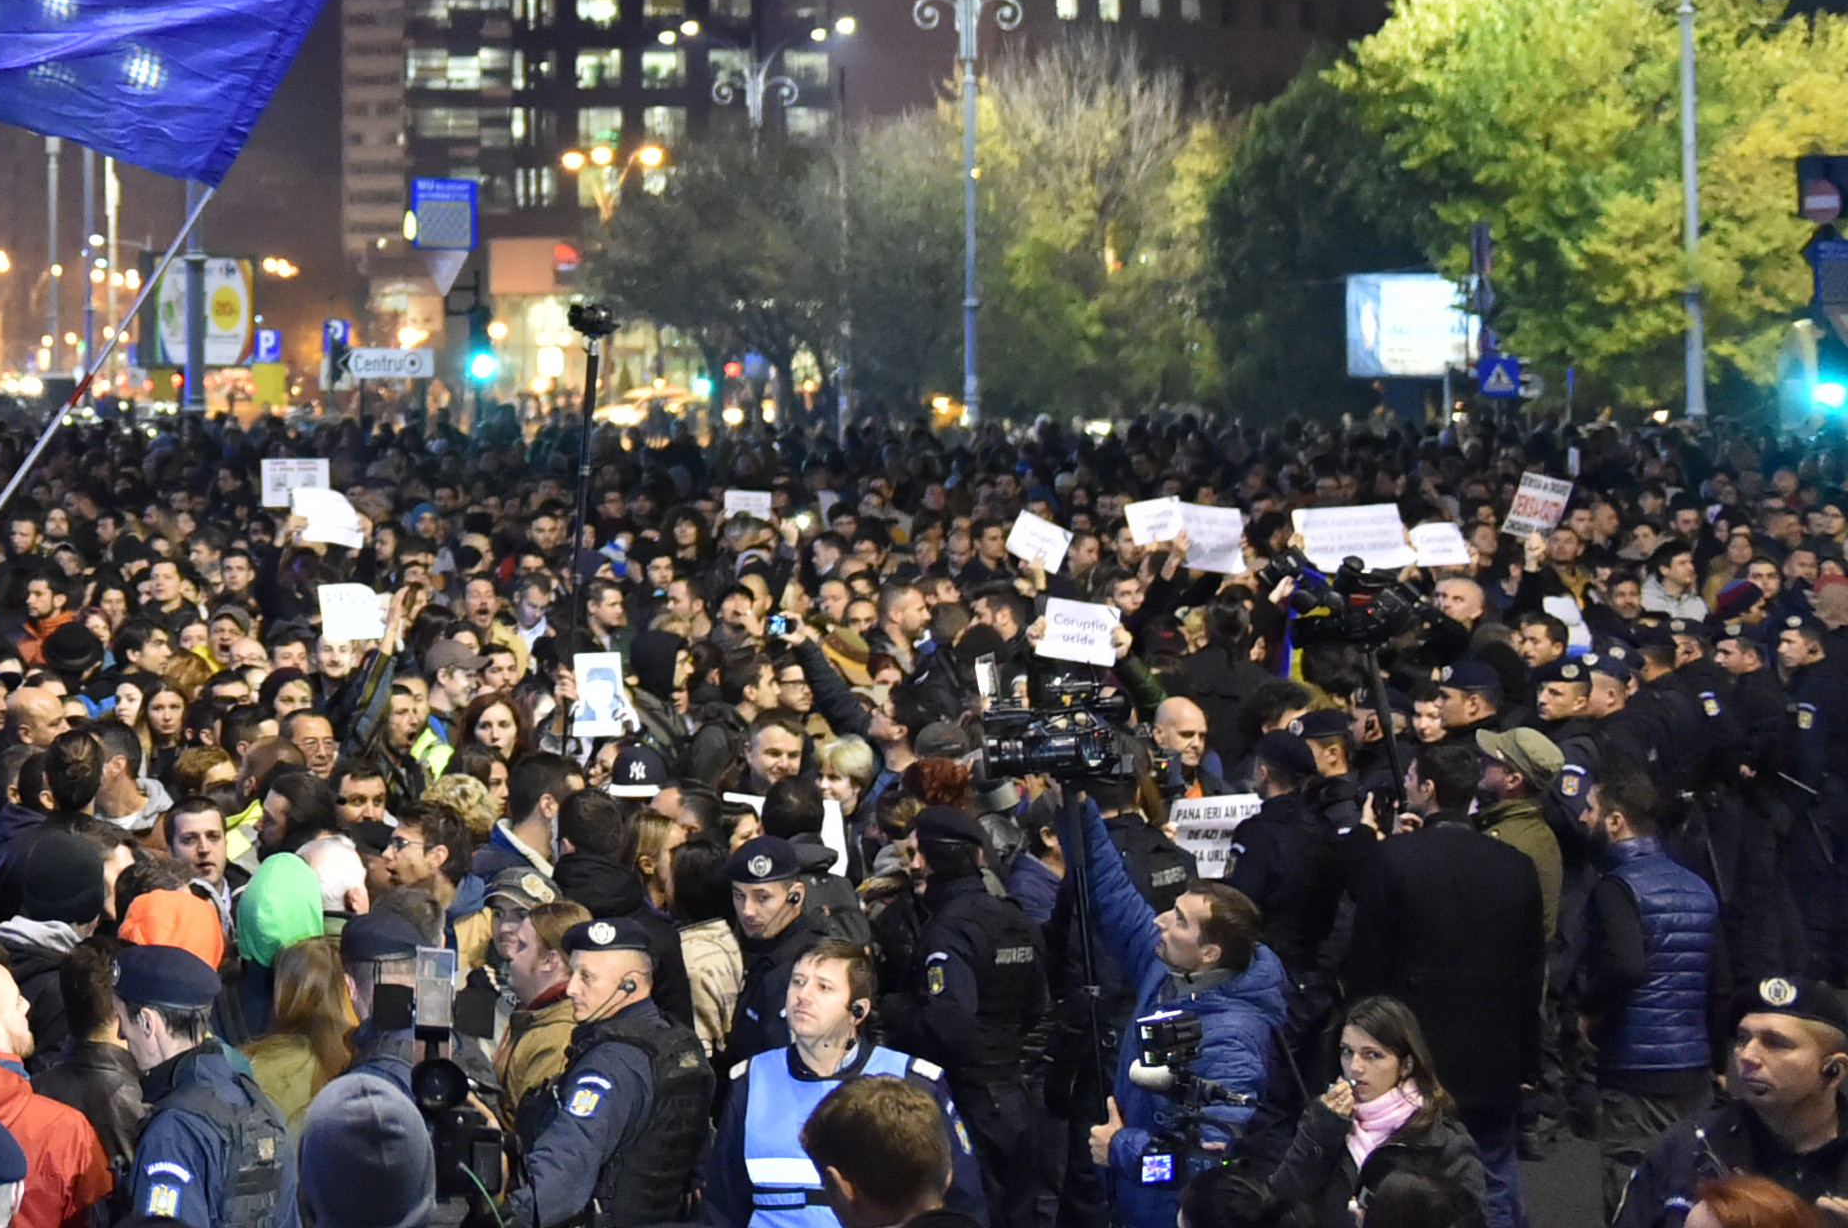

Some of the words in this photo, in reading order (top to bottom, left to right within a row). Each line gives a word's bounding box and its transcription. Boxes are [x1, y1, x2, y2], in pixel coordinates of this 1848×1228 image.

[258, 330, 276, 359] P
[354, 355, 404, 372] Centru
[1062, 633, 1095, 645] ucide
[1176, 808, 1201, 821] PANA
[1203, 806, 1222, 819] IERI
[1224, 805, 1237, 818] AM
[1187, 829, 1202, 840] DE
[1201, 829, 1219, 840] AZI
